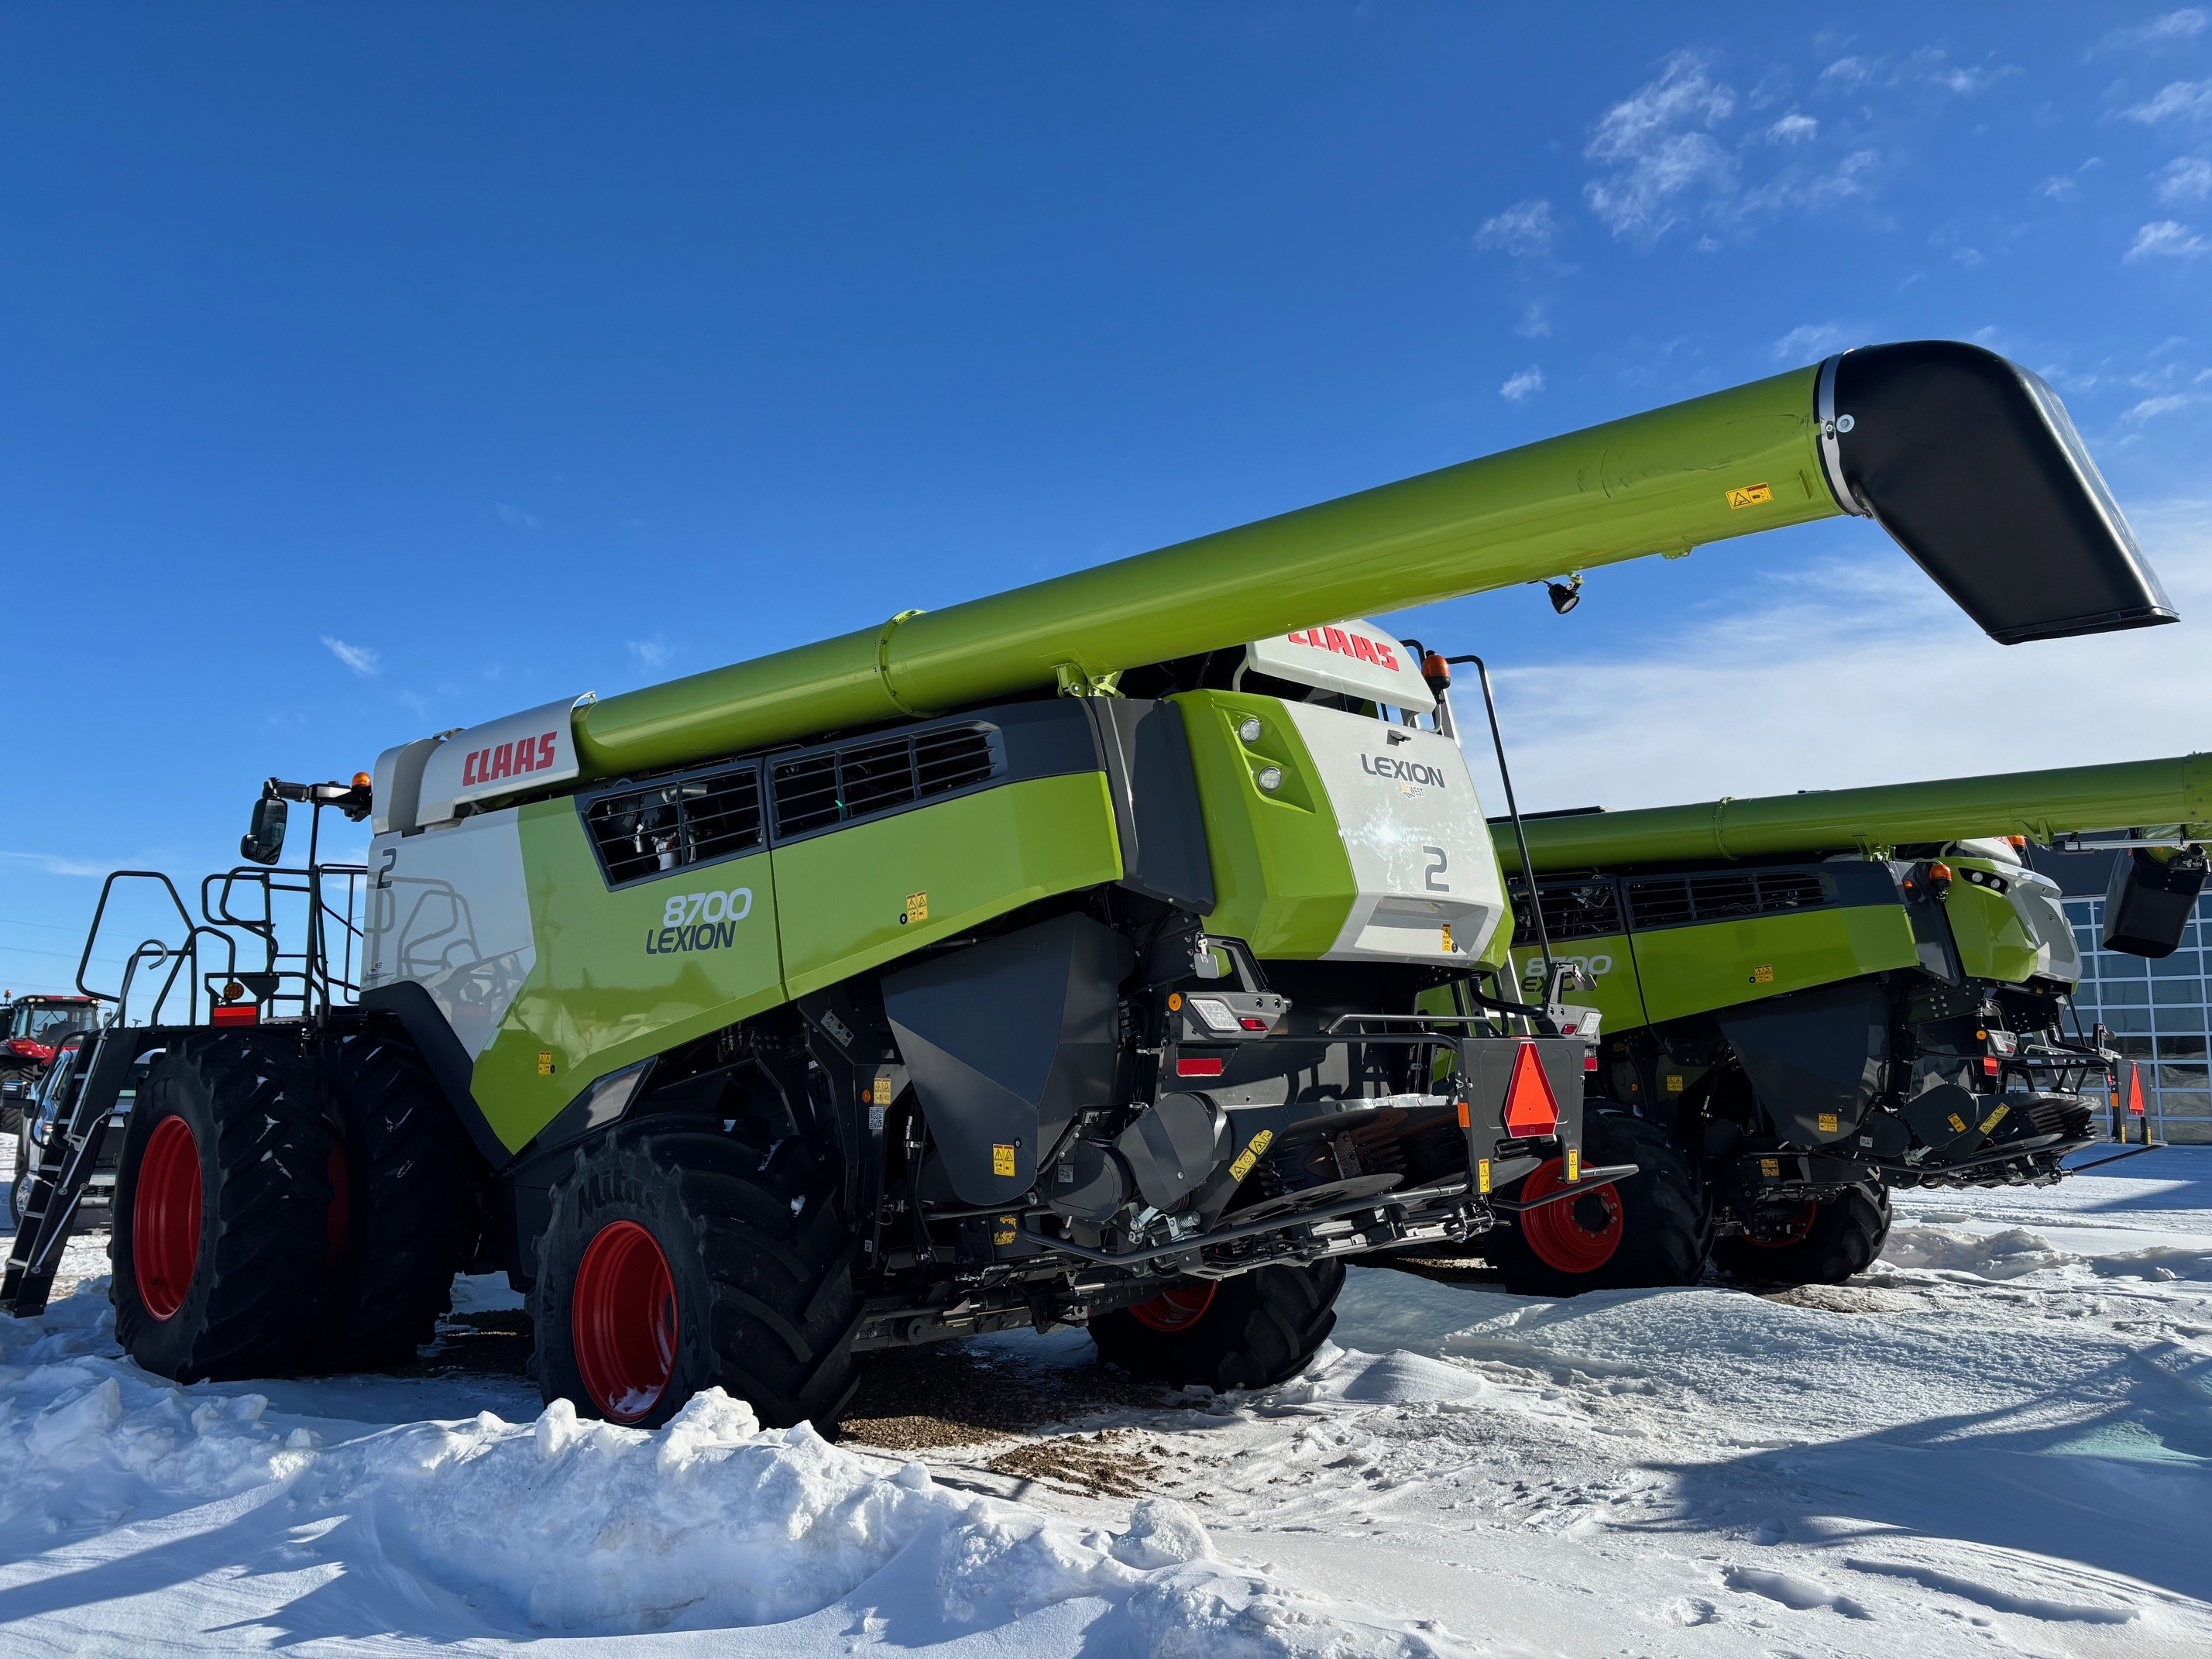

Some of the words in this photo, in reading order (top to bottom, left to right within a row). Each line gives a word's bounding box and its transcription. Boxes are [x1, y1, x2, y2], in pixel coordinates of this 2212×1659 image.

[462, 730, 558, 787] CLAAS
[1361, 754, 1446, 788] LEXION
[376, 847, 397, 890] 2
[1422, 845, 1450, 893] 2
[663, 887, 753, 928] 8700
[645, 920, 737, 955] LEXION
